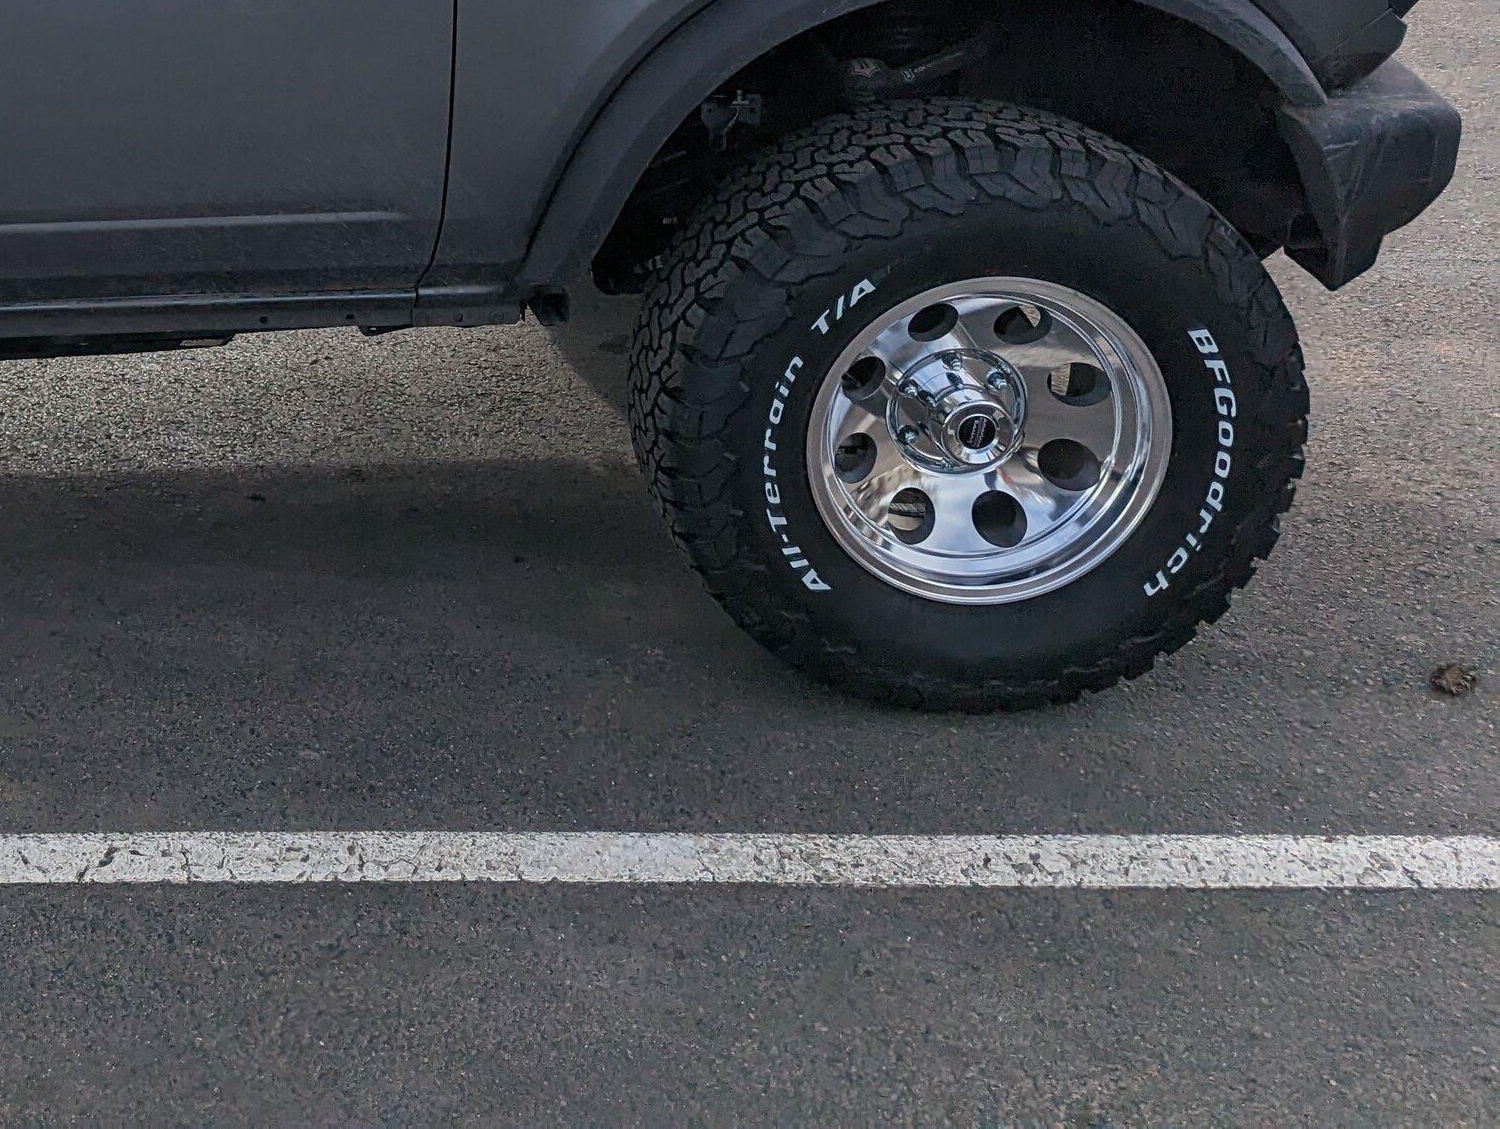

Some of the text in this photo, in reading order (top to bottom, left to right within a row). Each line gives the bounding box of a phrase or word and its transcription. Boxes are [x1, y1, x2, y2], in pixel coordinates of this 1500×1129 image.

[763, 278, 877, 591] All-Terrain T/A
[1143, 329, 1237, 597] BFGoodrich
